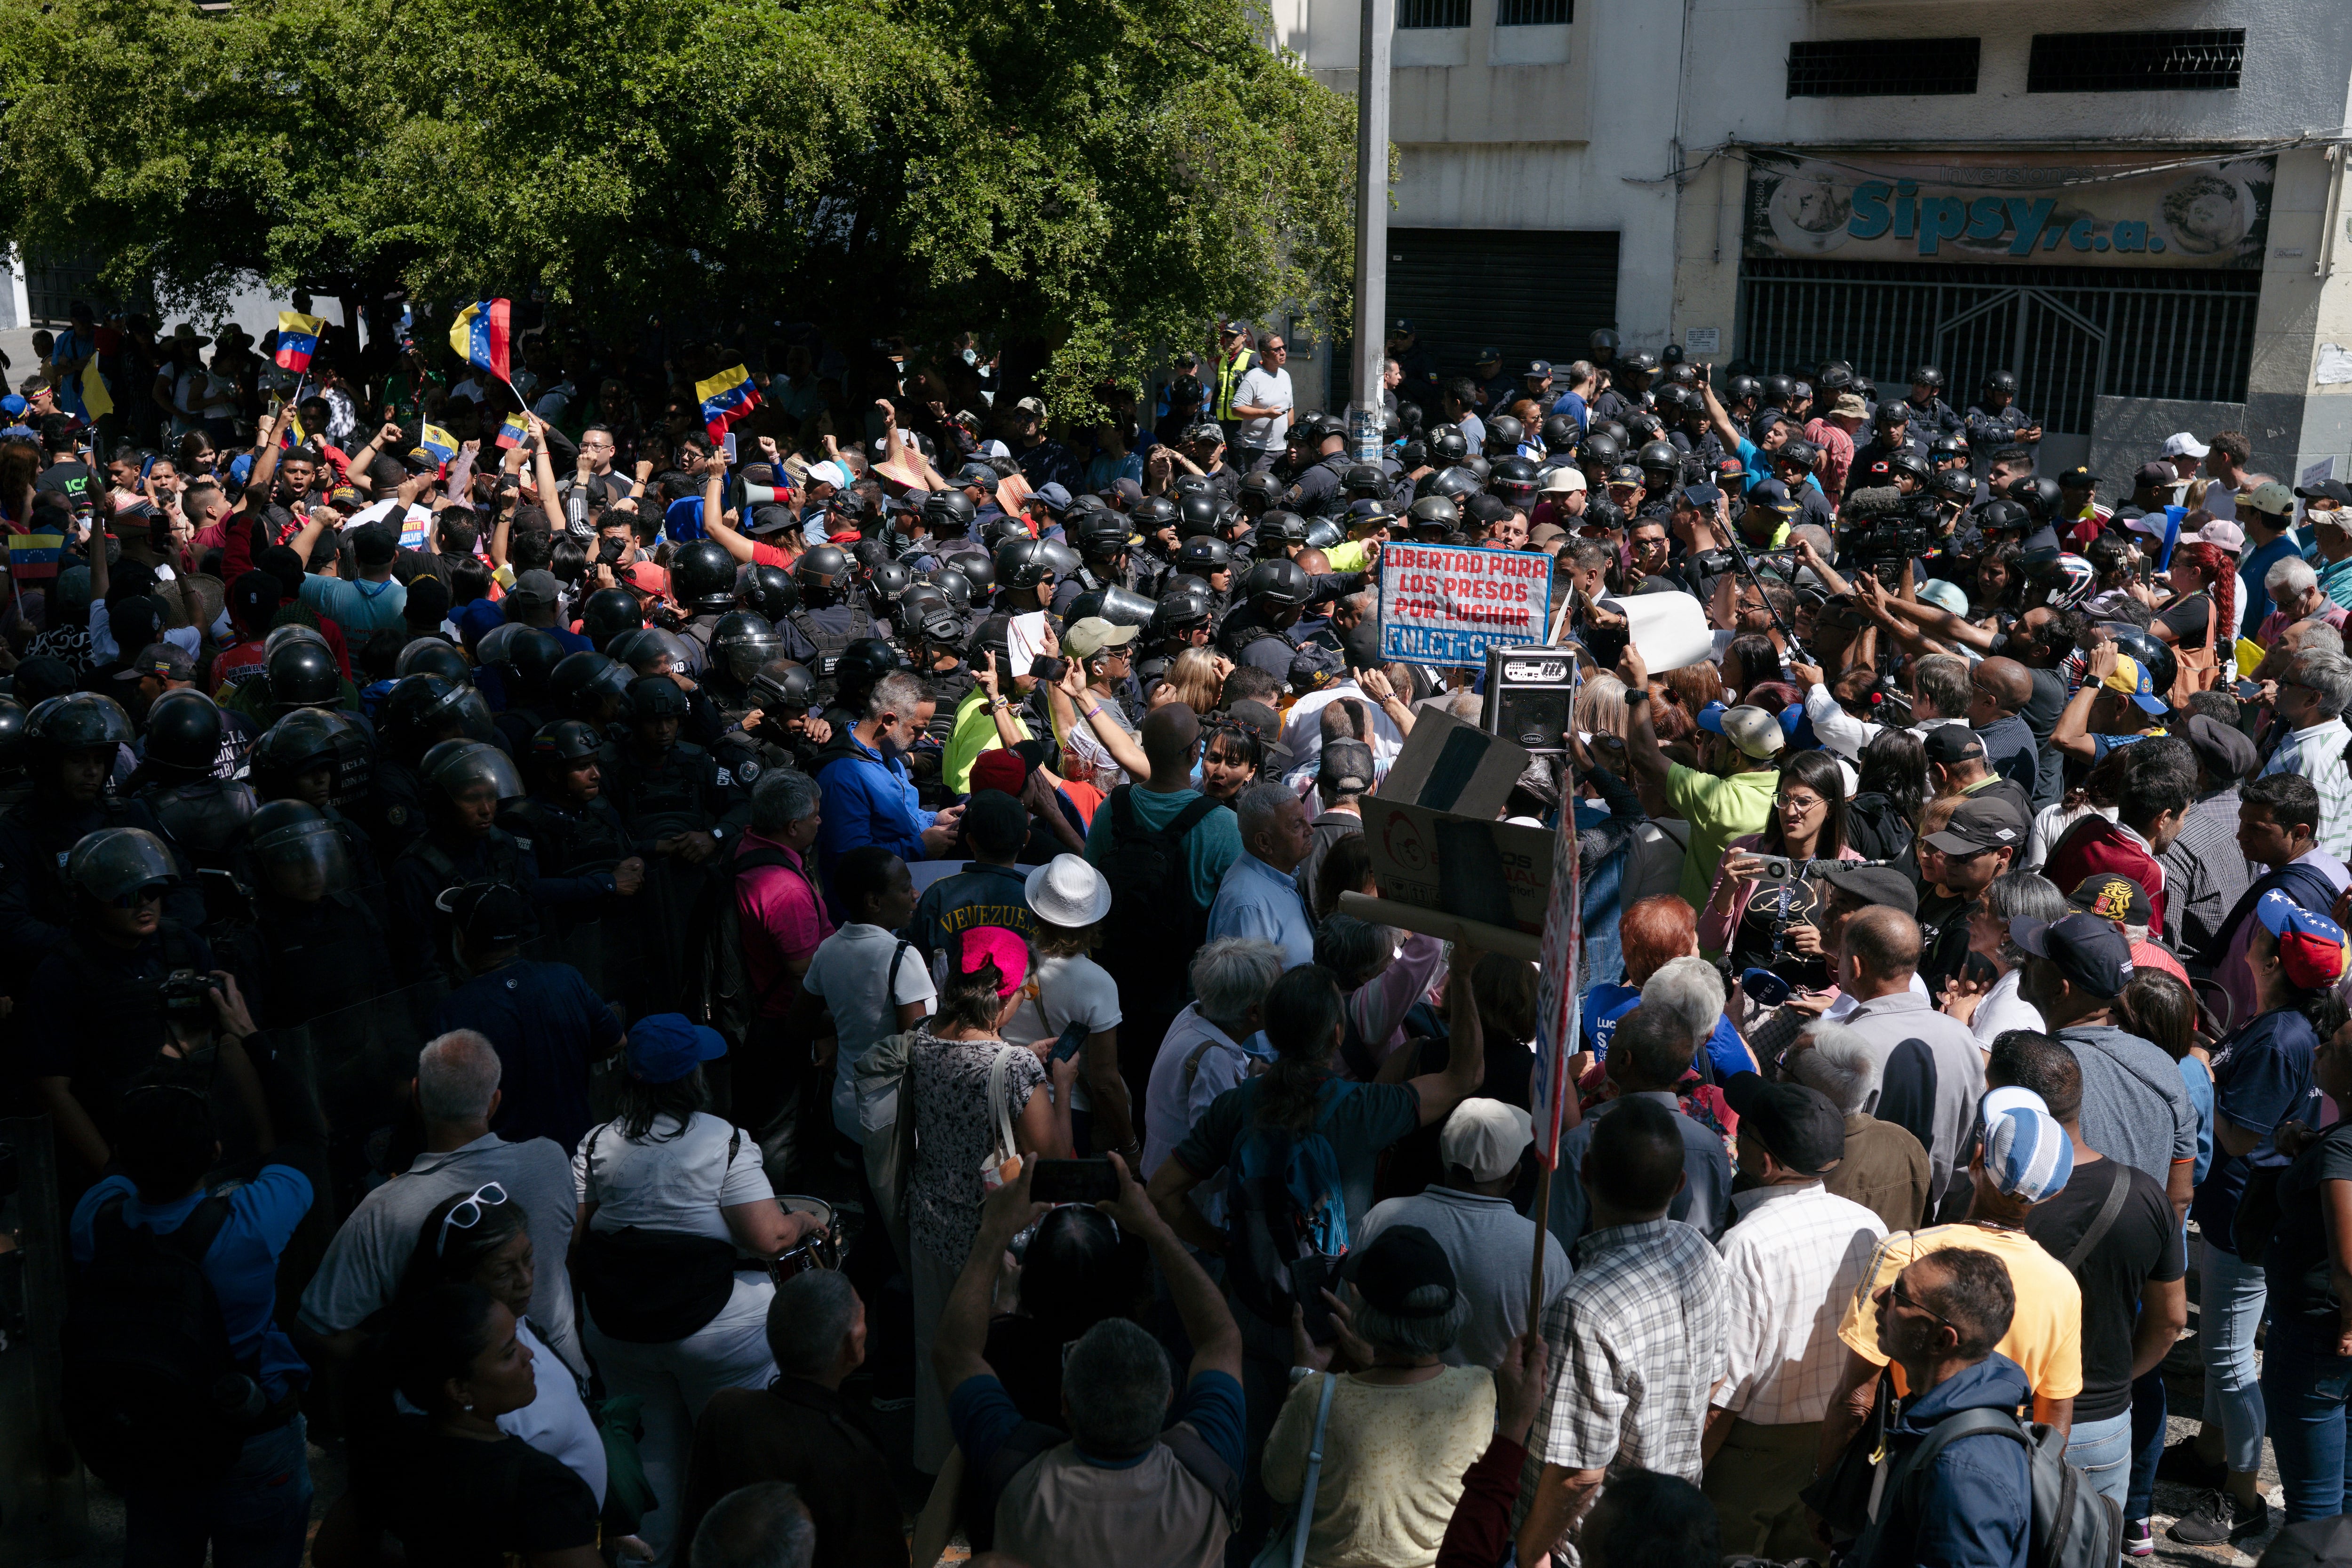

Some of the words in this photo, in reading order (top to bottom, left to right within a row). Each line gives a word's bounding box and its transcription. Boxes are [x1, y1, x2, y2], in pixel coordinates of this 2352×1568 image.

[1940, 164, 2097, 183] Inversiones
[1431, 428, 1443, 445] CPNB
[402, 521, 422, 532] ENTE
[949, 560, 965, 570] DIVISION
[1384, 548, 1483, 573] LIBERTAD
[1488, 556, 1546, 579] PARA
[1399, 573, 1438, 595] LOS
[1443, 577, 1528, 602] PRESOS
[1394, 597, 1438, 619] POR
[1445, 602, 1530, 627] LUCHAR
[227, 667, 238, 677] QUE
[238, 664, 252, 674] VIVA
[253, 664, 260, 673] EL
[669, 661, 685, 674] PNB
[716, 766, 731, 786] CPNB
[1597, 1016, 1617, 1029] Luc
